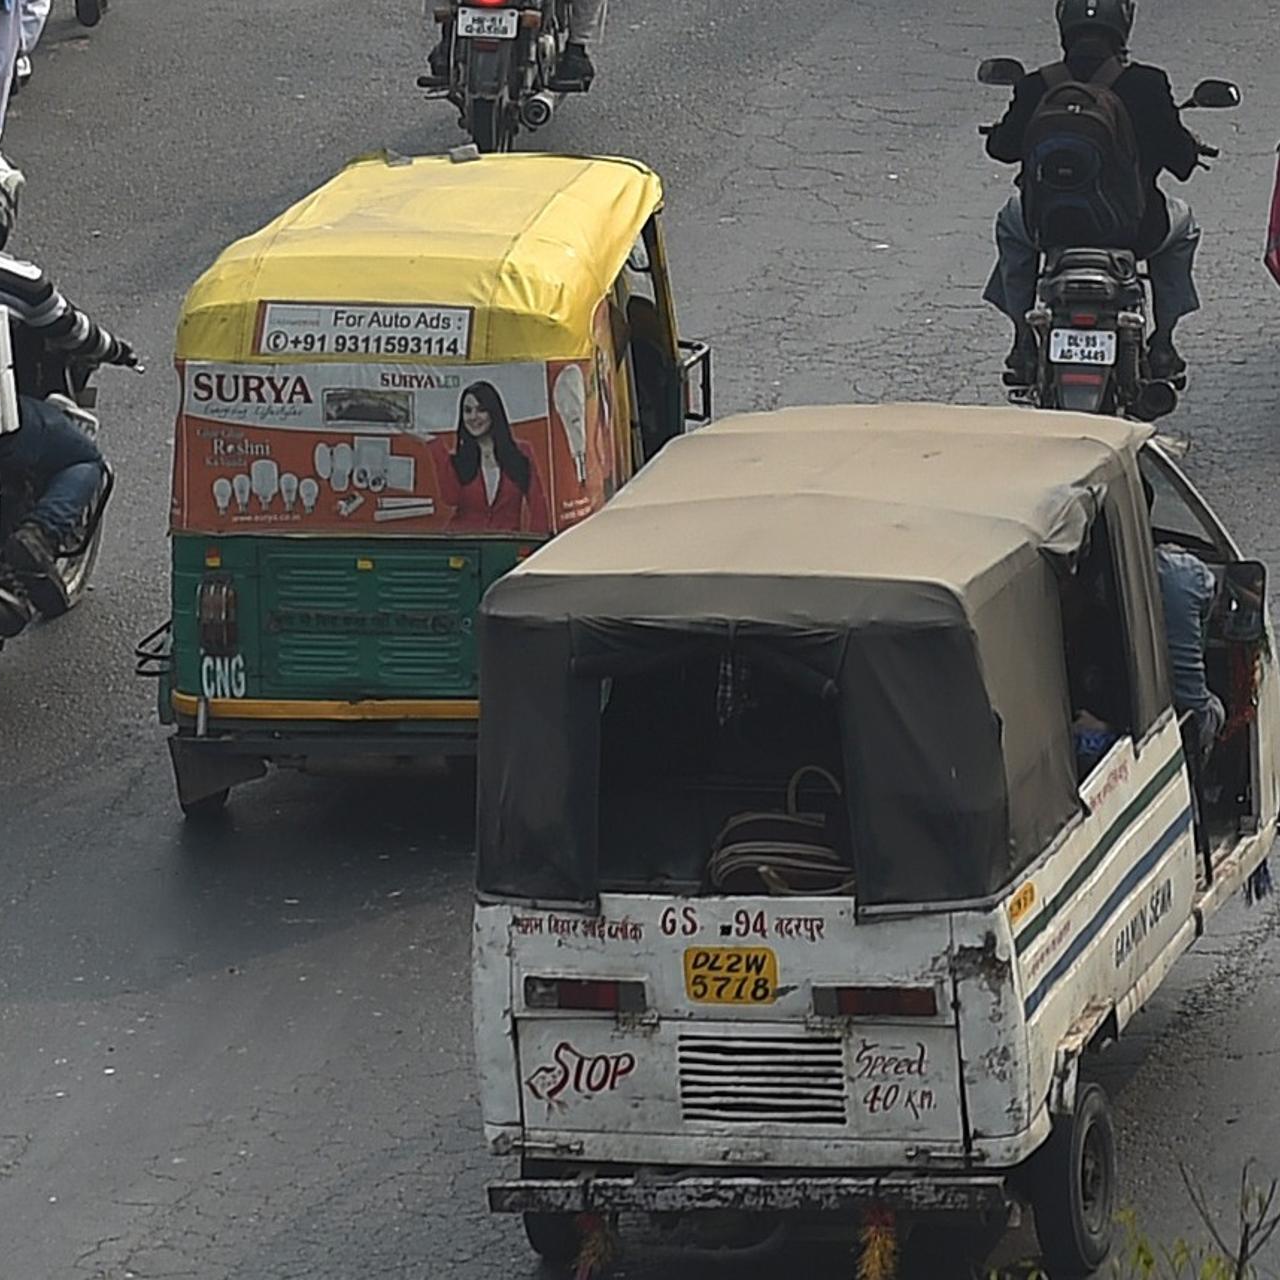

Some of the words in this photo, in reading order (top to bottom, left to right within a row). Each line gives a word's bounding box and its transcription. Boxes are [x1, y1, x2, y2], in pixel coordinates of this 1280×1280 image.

[333, 310, 365, 329] For
[369, 310, 411, 331] Auto
[415, 311, 453, 331] Ads
[290, 334, 328, 354] +91
[334, 334, 461, 356] 9311593114
[193, 372, 314, 405] SURYA
[379, 373, 434, 388] SURYA
[201, 652, 246, 699] CNG
[691, 952, 767, 976] DL2W
[554, 1041, 637, 1100] STOP
[855, 1040, 927, 1080] Speed
[863, 1084, 900, 1114] 40
